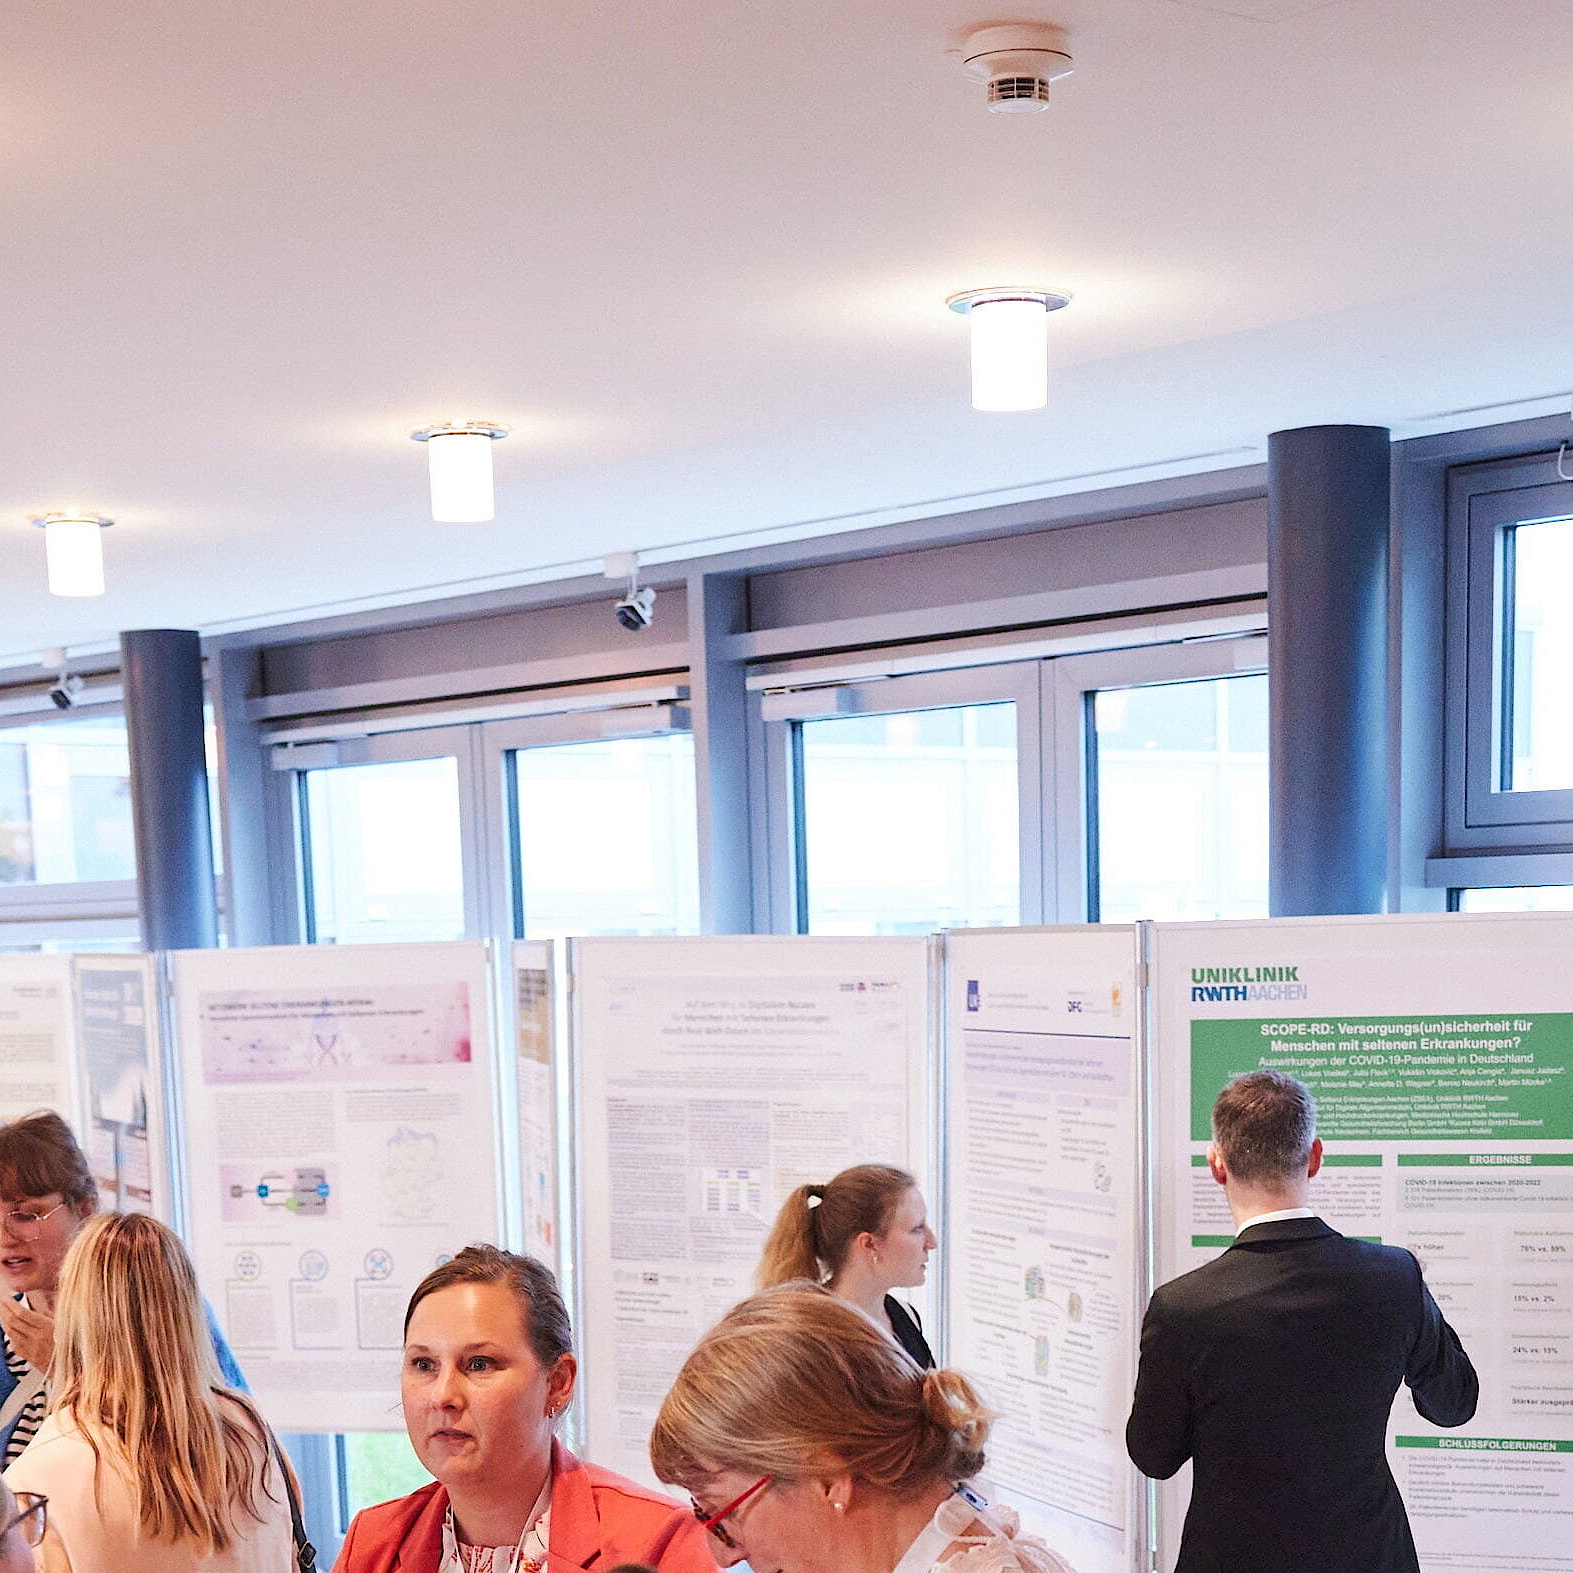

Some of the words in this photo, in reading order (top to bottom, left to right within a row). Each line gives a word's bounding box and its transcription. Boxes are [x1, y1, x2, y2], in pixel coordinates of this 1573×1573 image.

[1192, 967, 1299, 983] UNIKLINIK
[1261, 1023, 1334, 1035] SCOPE-RD:
[1338, 1021, 1510, 1036] Versorgungs(un)sicherheit
[1514, 1020, 1533, 1031] für
[1271, 1041, 1335, 1051] Menschen
[1339, 1041, 1358, 1050] mit
[1363, 1039, 1416, 1050] seltenen
[1421, 1037, 1521, 1051] Erkrankungen?
[1258, 1057, 1327, 1067] Auswirkungen
[1330, 1056, 1346, 1065] der
[1350, 1054, 1455, 1065] COVID-19-Pandemie
[1458, 1054, 1466, 1064] in
[1470, 1054, 1533, 1064] Deutschland
[1469, 1156, 1532, 1164] ERGEBNISSE
[1439, 1439, 1556, 1451] SCHLUSSFOLGERUNGEN
